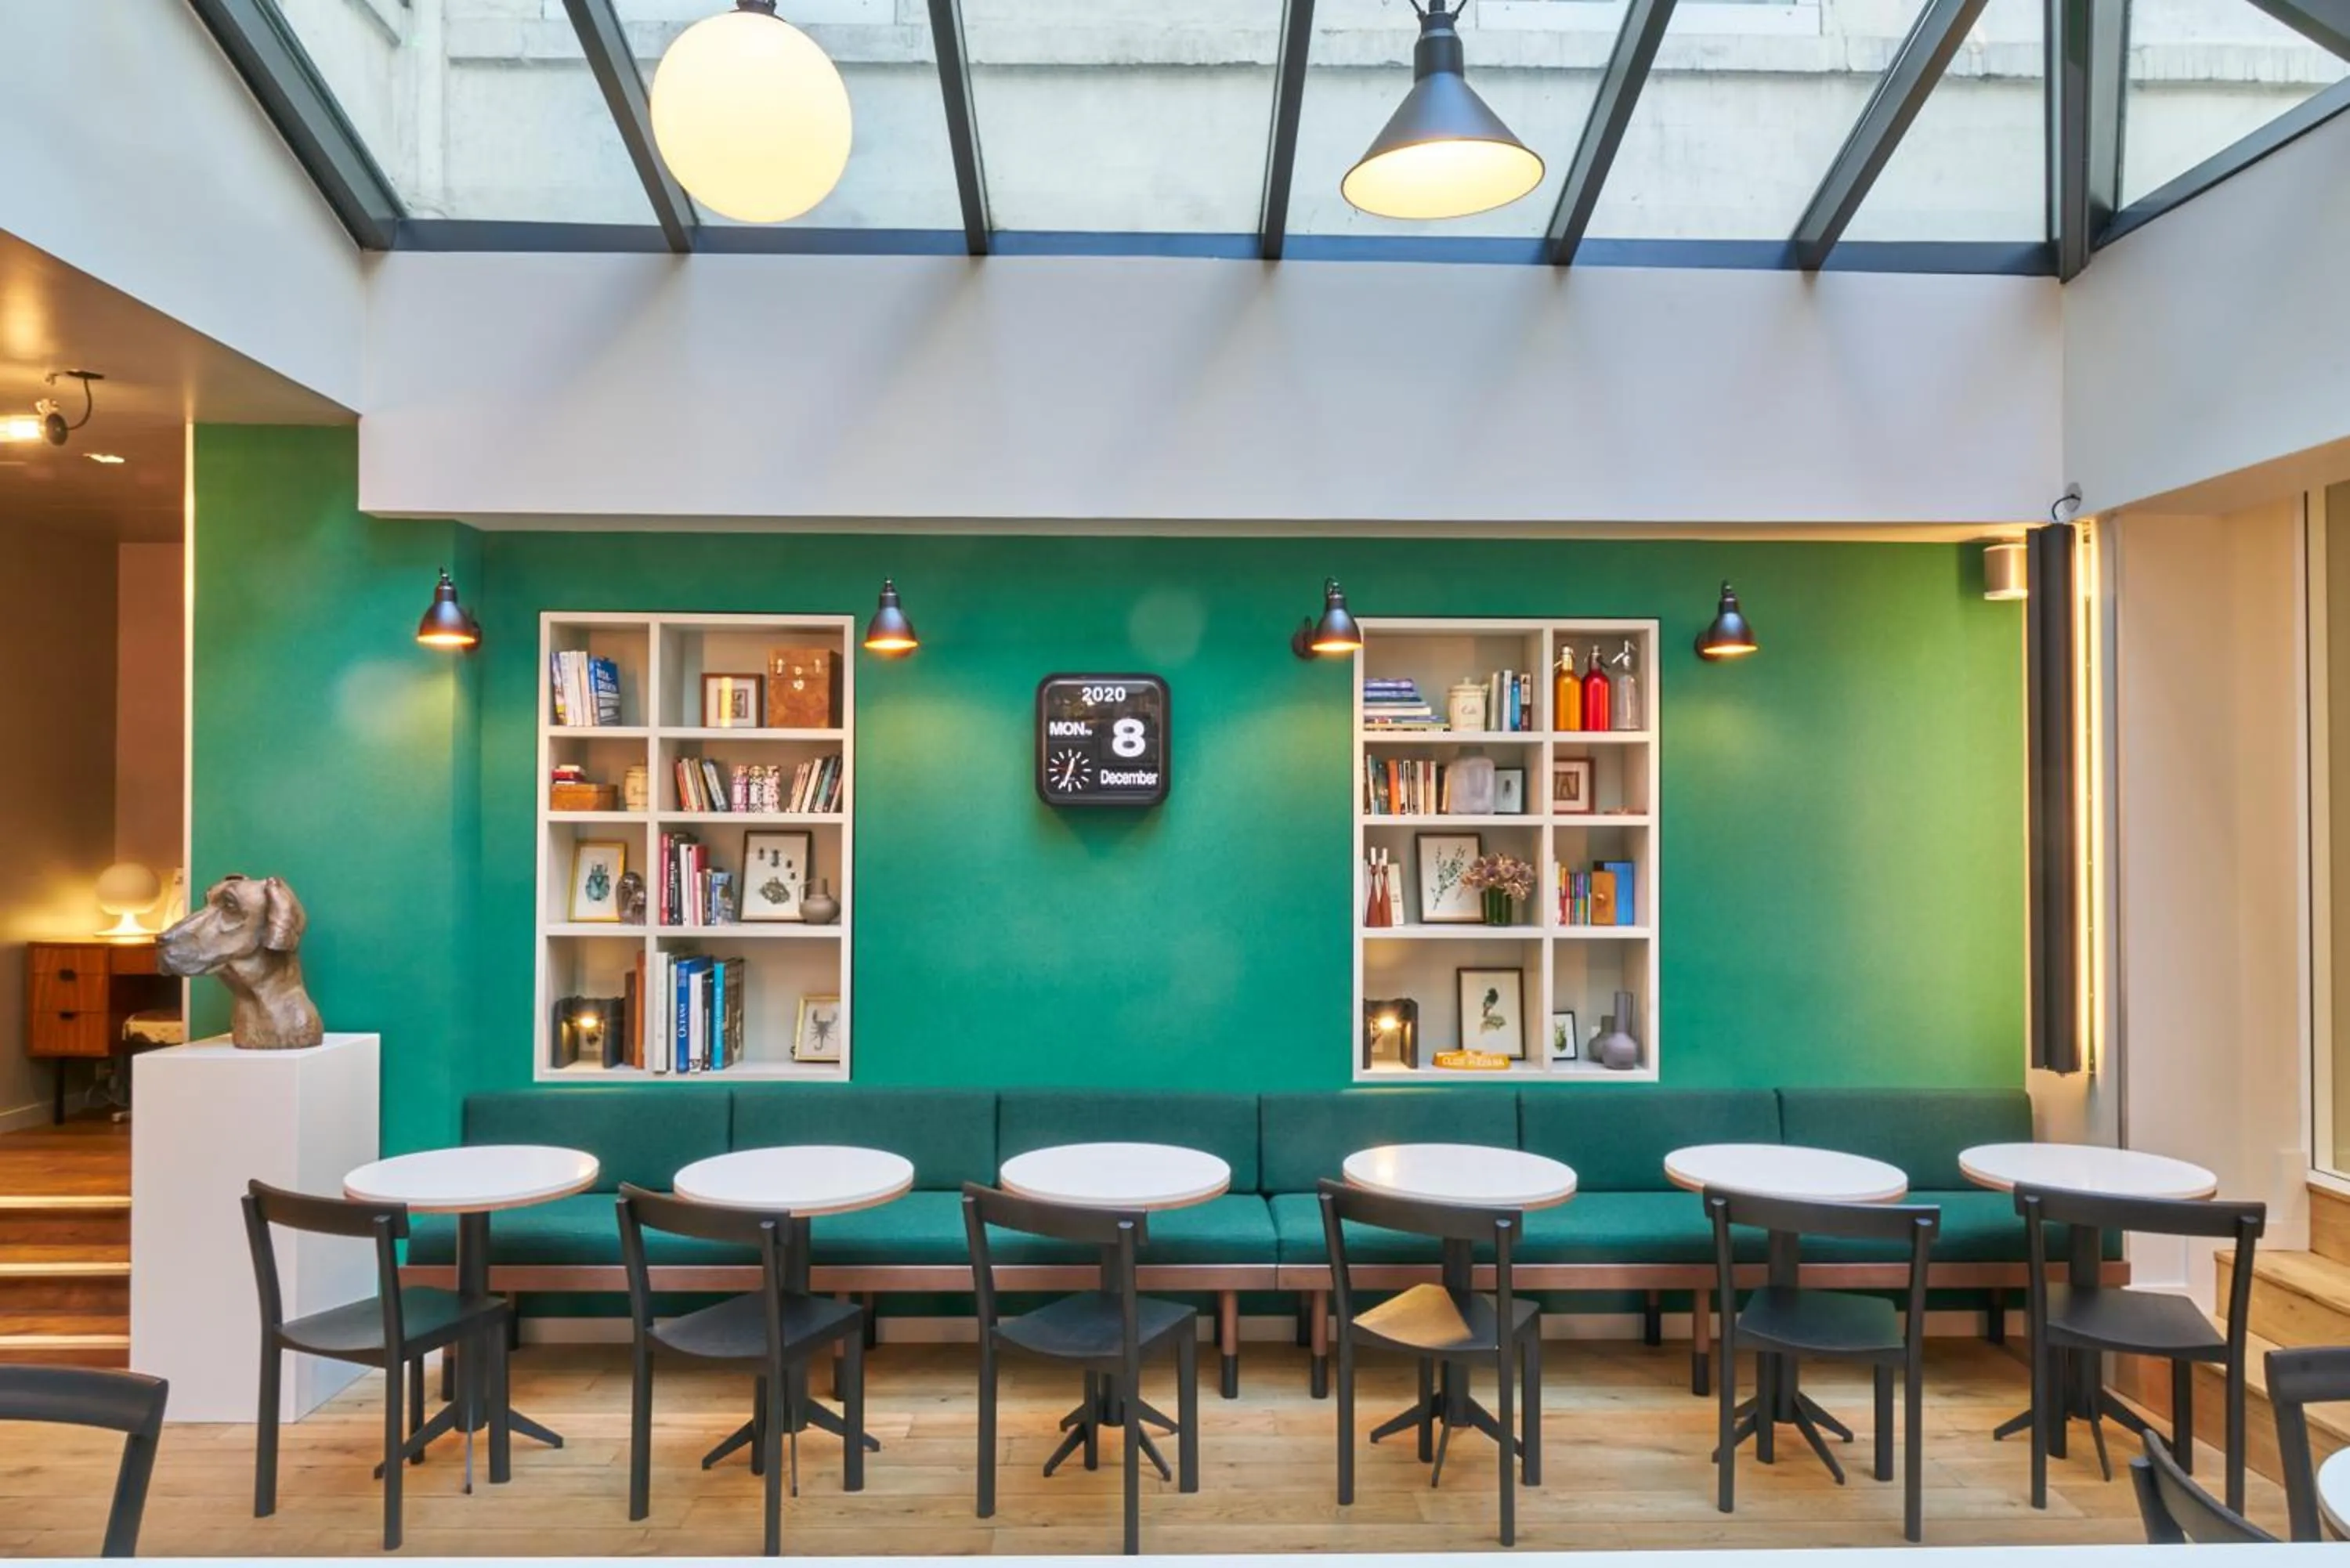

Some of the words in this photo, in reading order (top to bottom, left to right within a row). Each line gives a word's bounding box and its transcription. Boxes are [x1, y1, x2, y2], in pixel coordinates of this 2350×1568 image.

[1082, 686, 1126, 702] 2020
[1049, 721, 1085, 736] MON
[1112, 718, 1146, 757] 8
[1101, 769, 1158, 785] December
